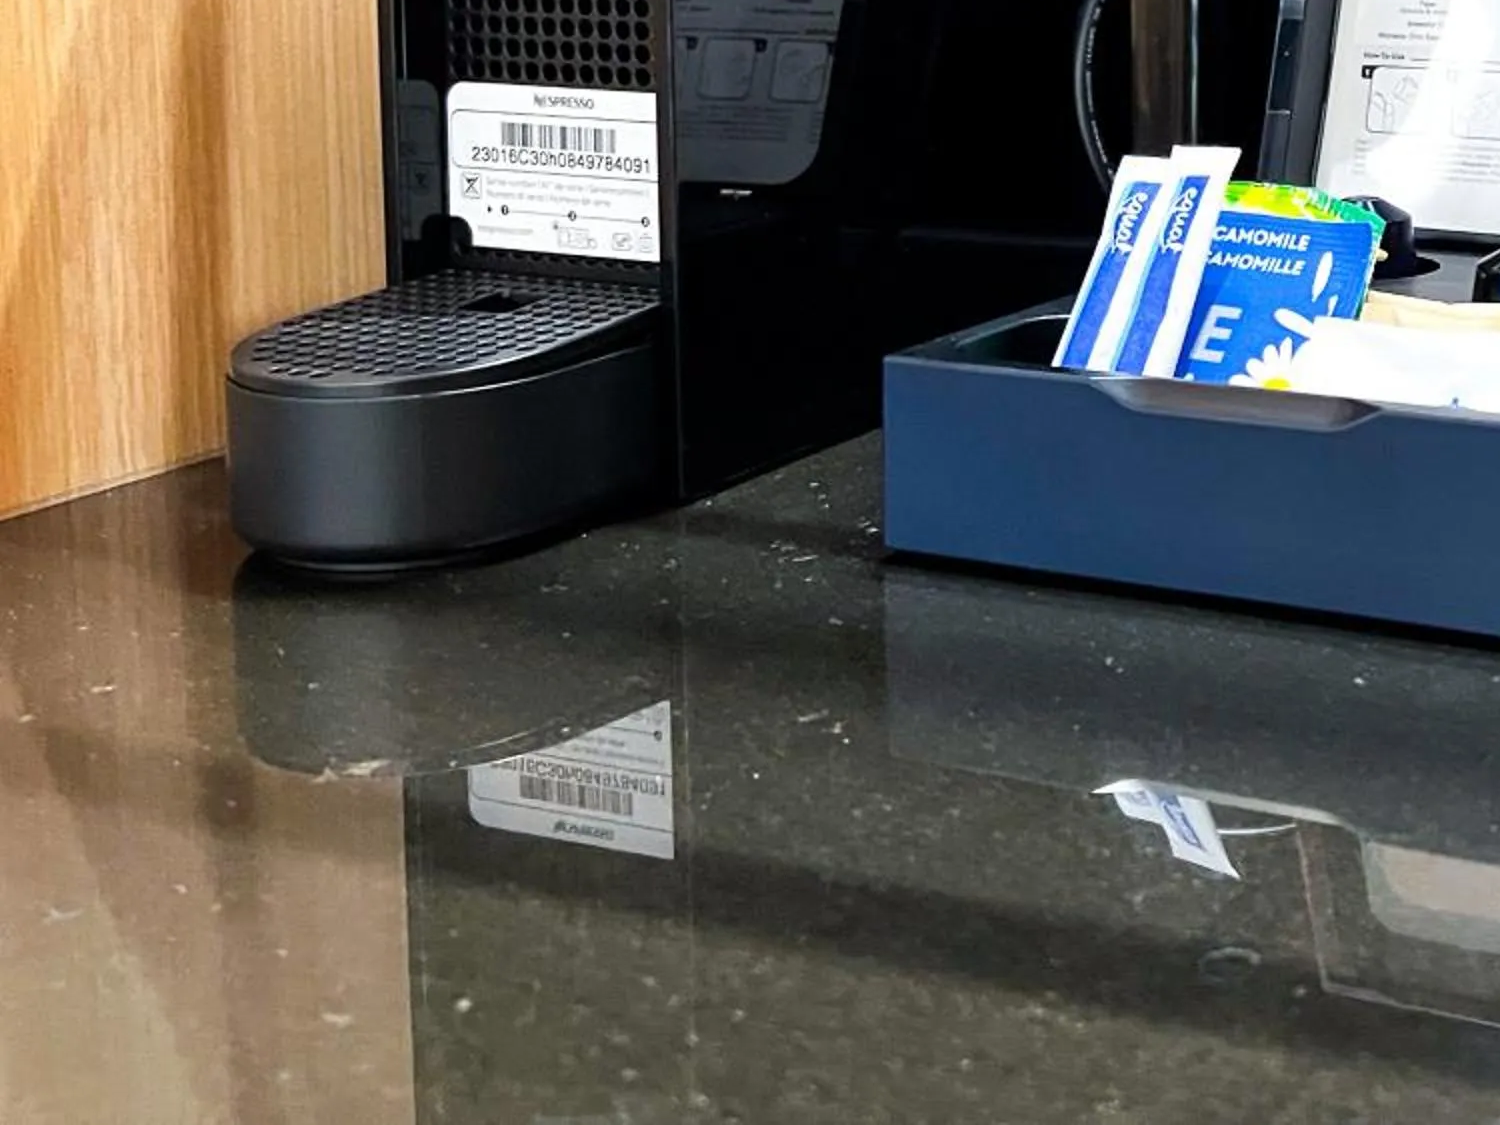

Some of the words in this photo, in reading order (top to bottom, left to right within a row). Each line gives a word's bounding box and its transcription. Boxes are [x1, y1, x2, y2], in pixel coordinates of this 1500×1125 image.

[533, 93, 595, 109] NESPRESSO
[1212, 225, 1311, 252] CAMOMILE
[1207, 250, 1306, 276] AMOMILLE
